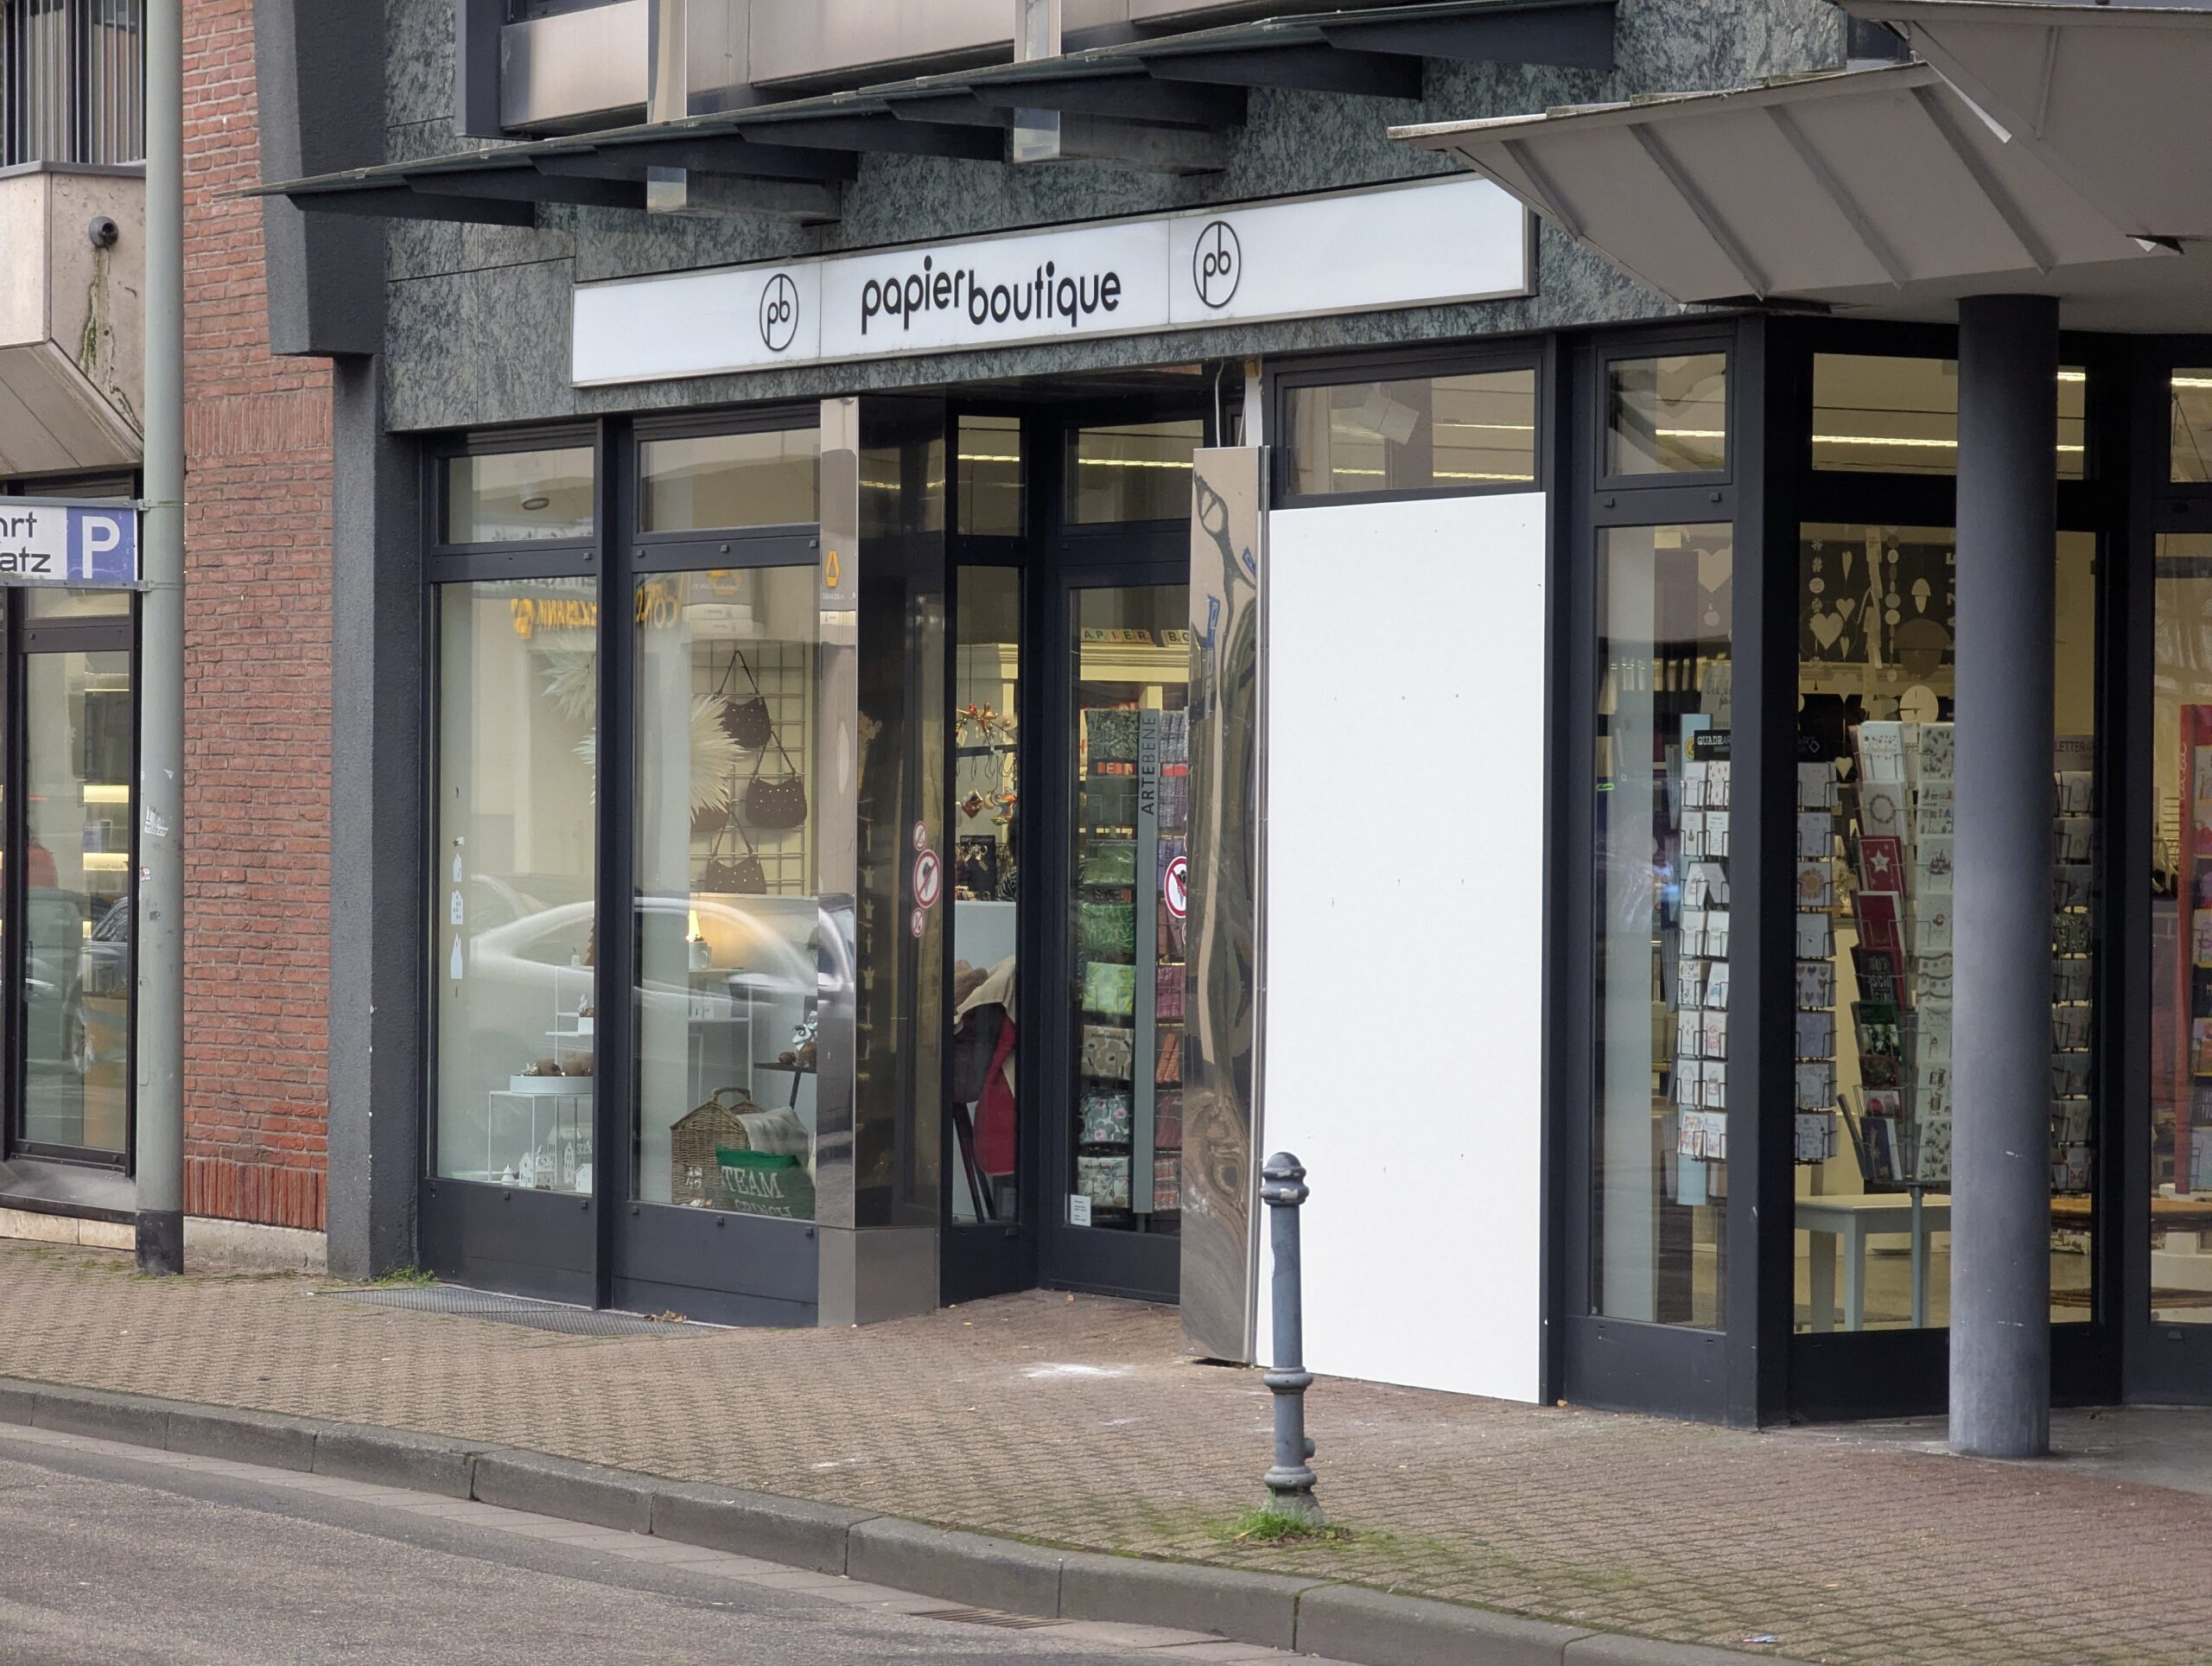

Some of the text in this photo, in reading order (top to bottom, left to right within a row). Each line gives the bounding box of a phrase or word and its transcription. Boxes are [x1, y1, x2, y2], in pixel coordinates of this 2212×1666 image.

[860, 253, 1121, 334] papierboutique
[82, 516, 120, 579] P
[1141, 715, 1156, 816] ARTEBENE
[721, 1166, 785, 1199] TEAM
